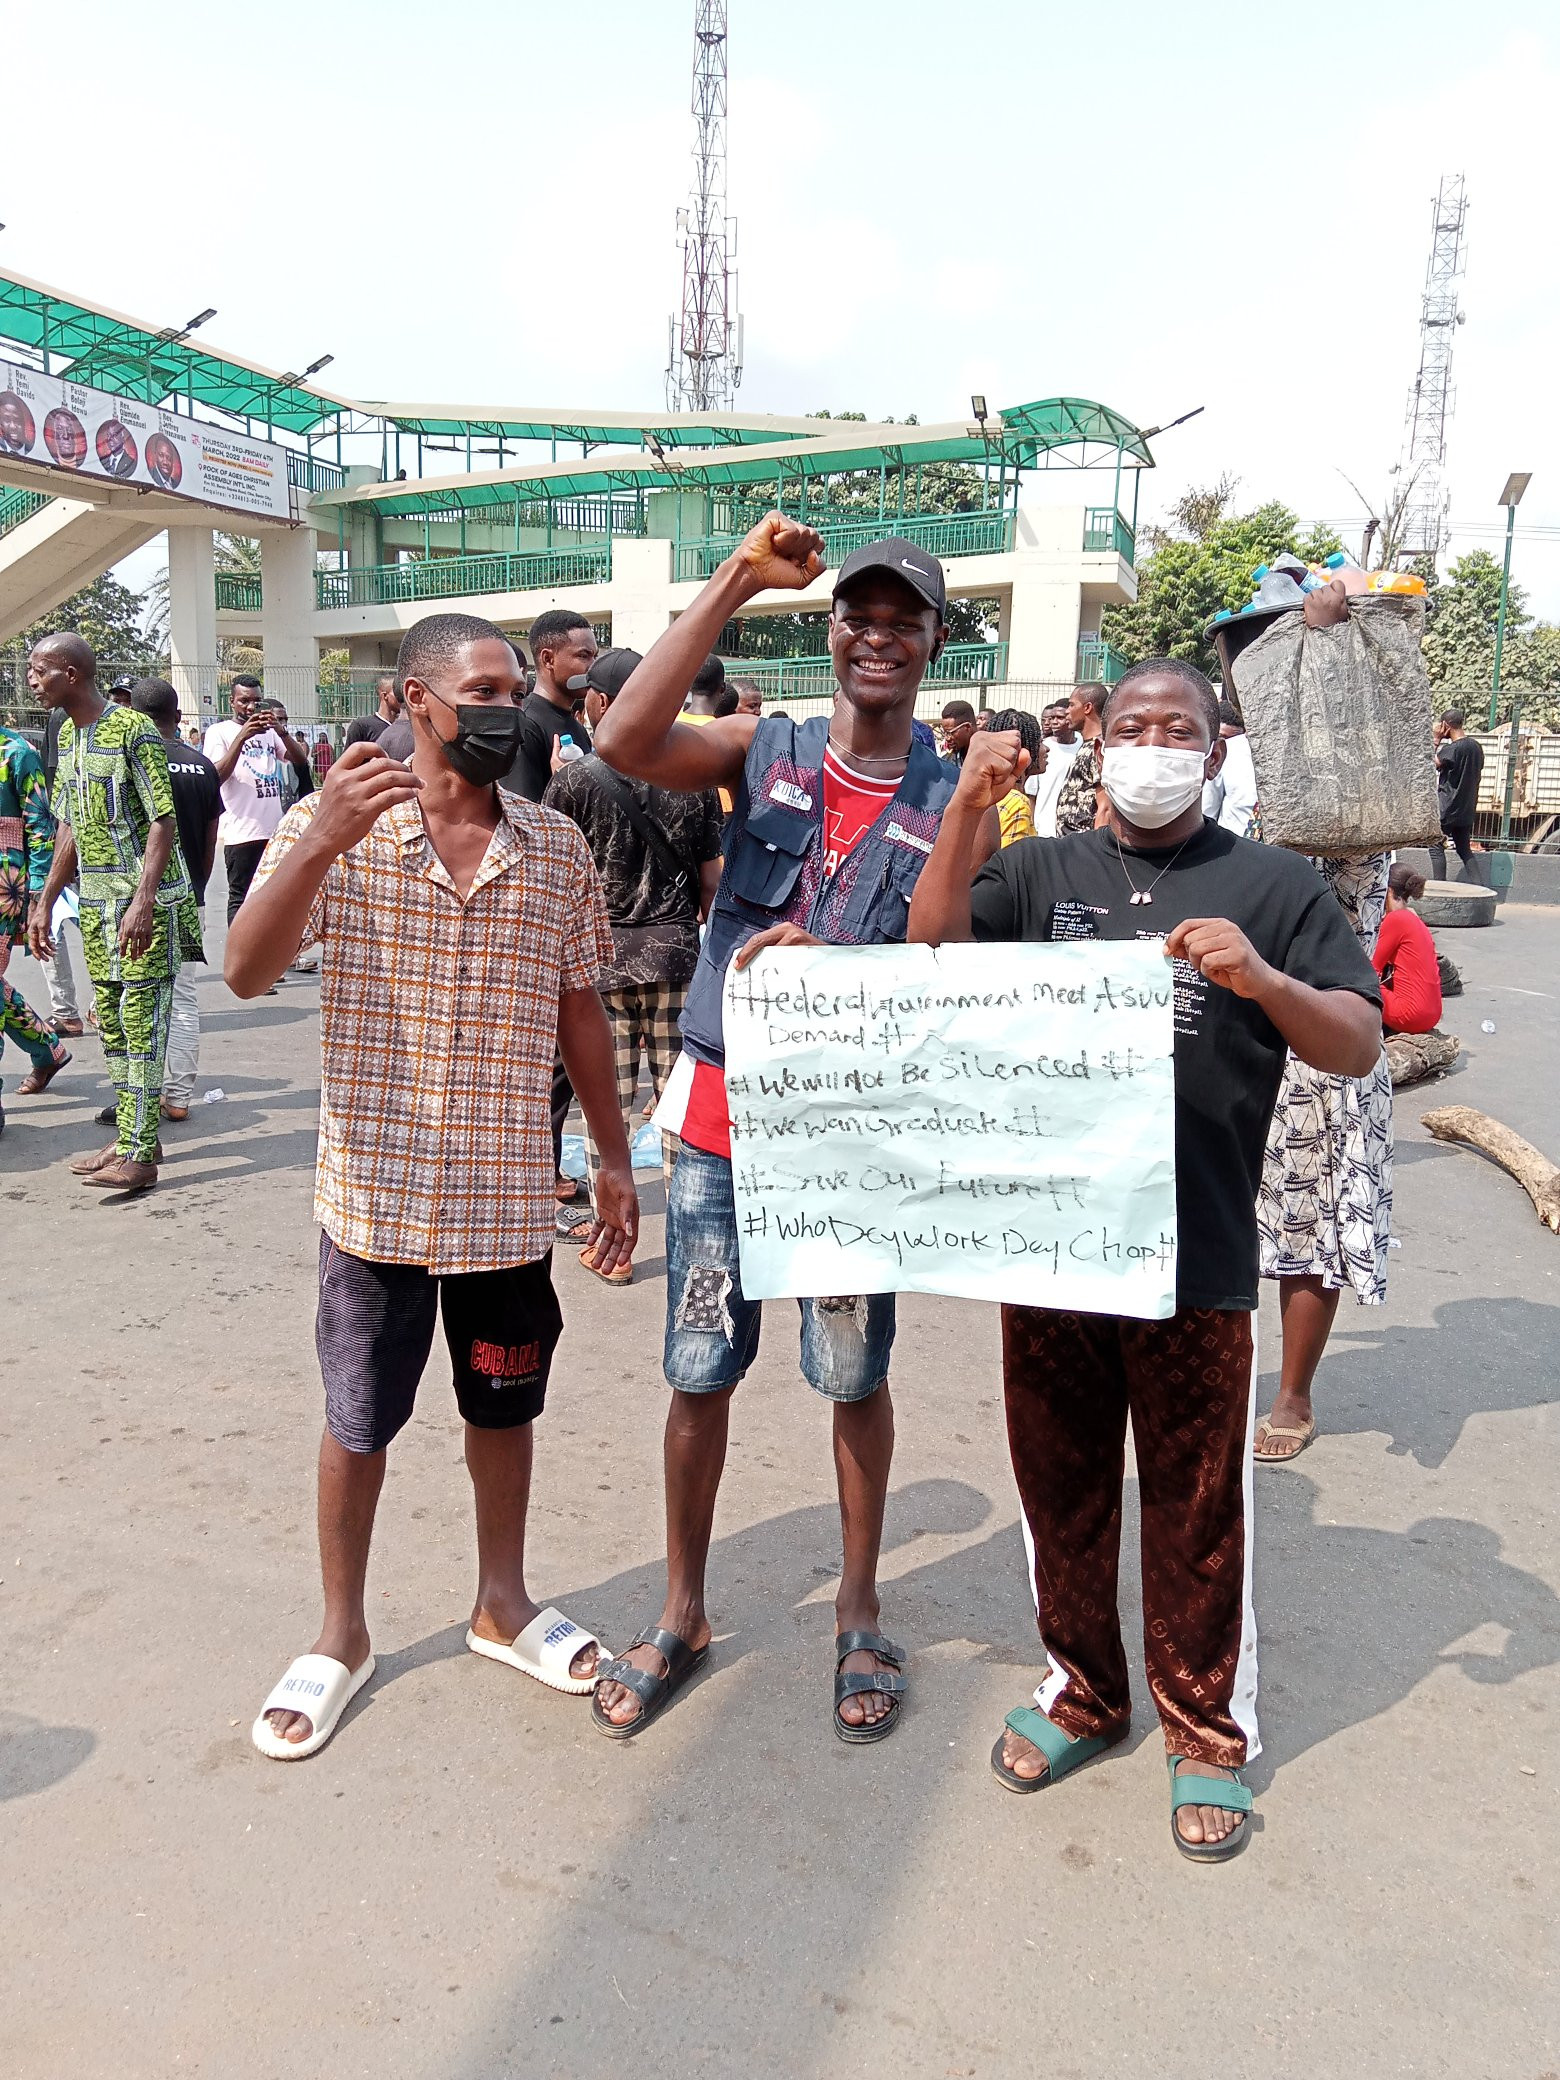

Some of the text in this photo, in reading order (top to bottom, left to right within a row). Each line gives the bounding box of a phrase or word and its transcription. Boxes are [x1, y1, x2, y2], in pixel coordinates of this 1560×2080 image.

[15, 369, 28, 381] Rev.
[16, 379, 30, 390] Yemi
[119, 401, 131, 411] Rev.
[162, 412, 174, 423] Rev.
[202, 436, 231, 451] THURSDAY
[225, 451, 241, 461] 2022
[254, 459, 270, 469] DAILY
[202, 464, 219, 474] ROCK
[219, 468, 228, 476] OF
[228, 471, 243, 481] AGES
[243, 475, 271, 487] CHRISTIAN
[203, 473, 233, 486] ASSEMBLY
[1055, 901, 1110, 915] LOUIS VUITTON
[469, 1339, 541, 1377] CUBANA
[543, 1620, 577, 1648] RETRO
[282, 1678, 325, 1697] RETRO
